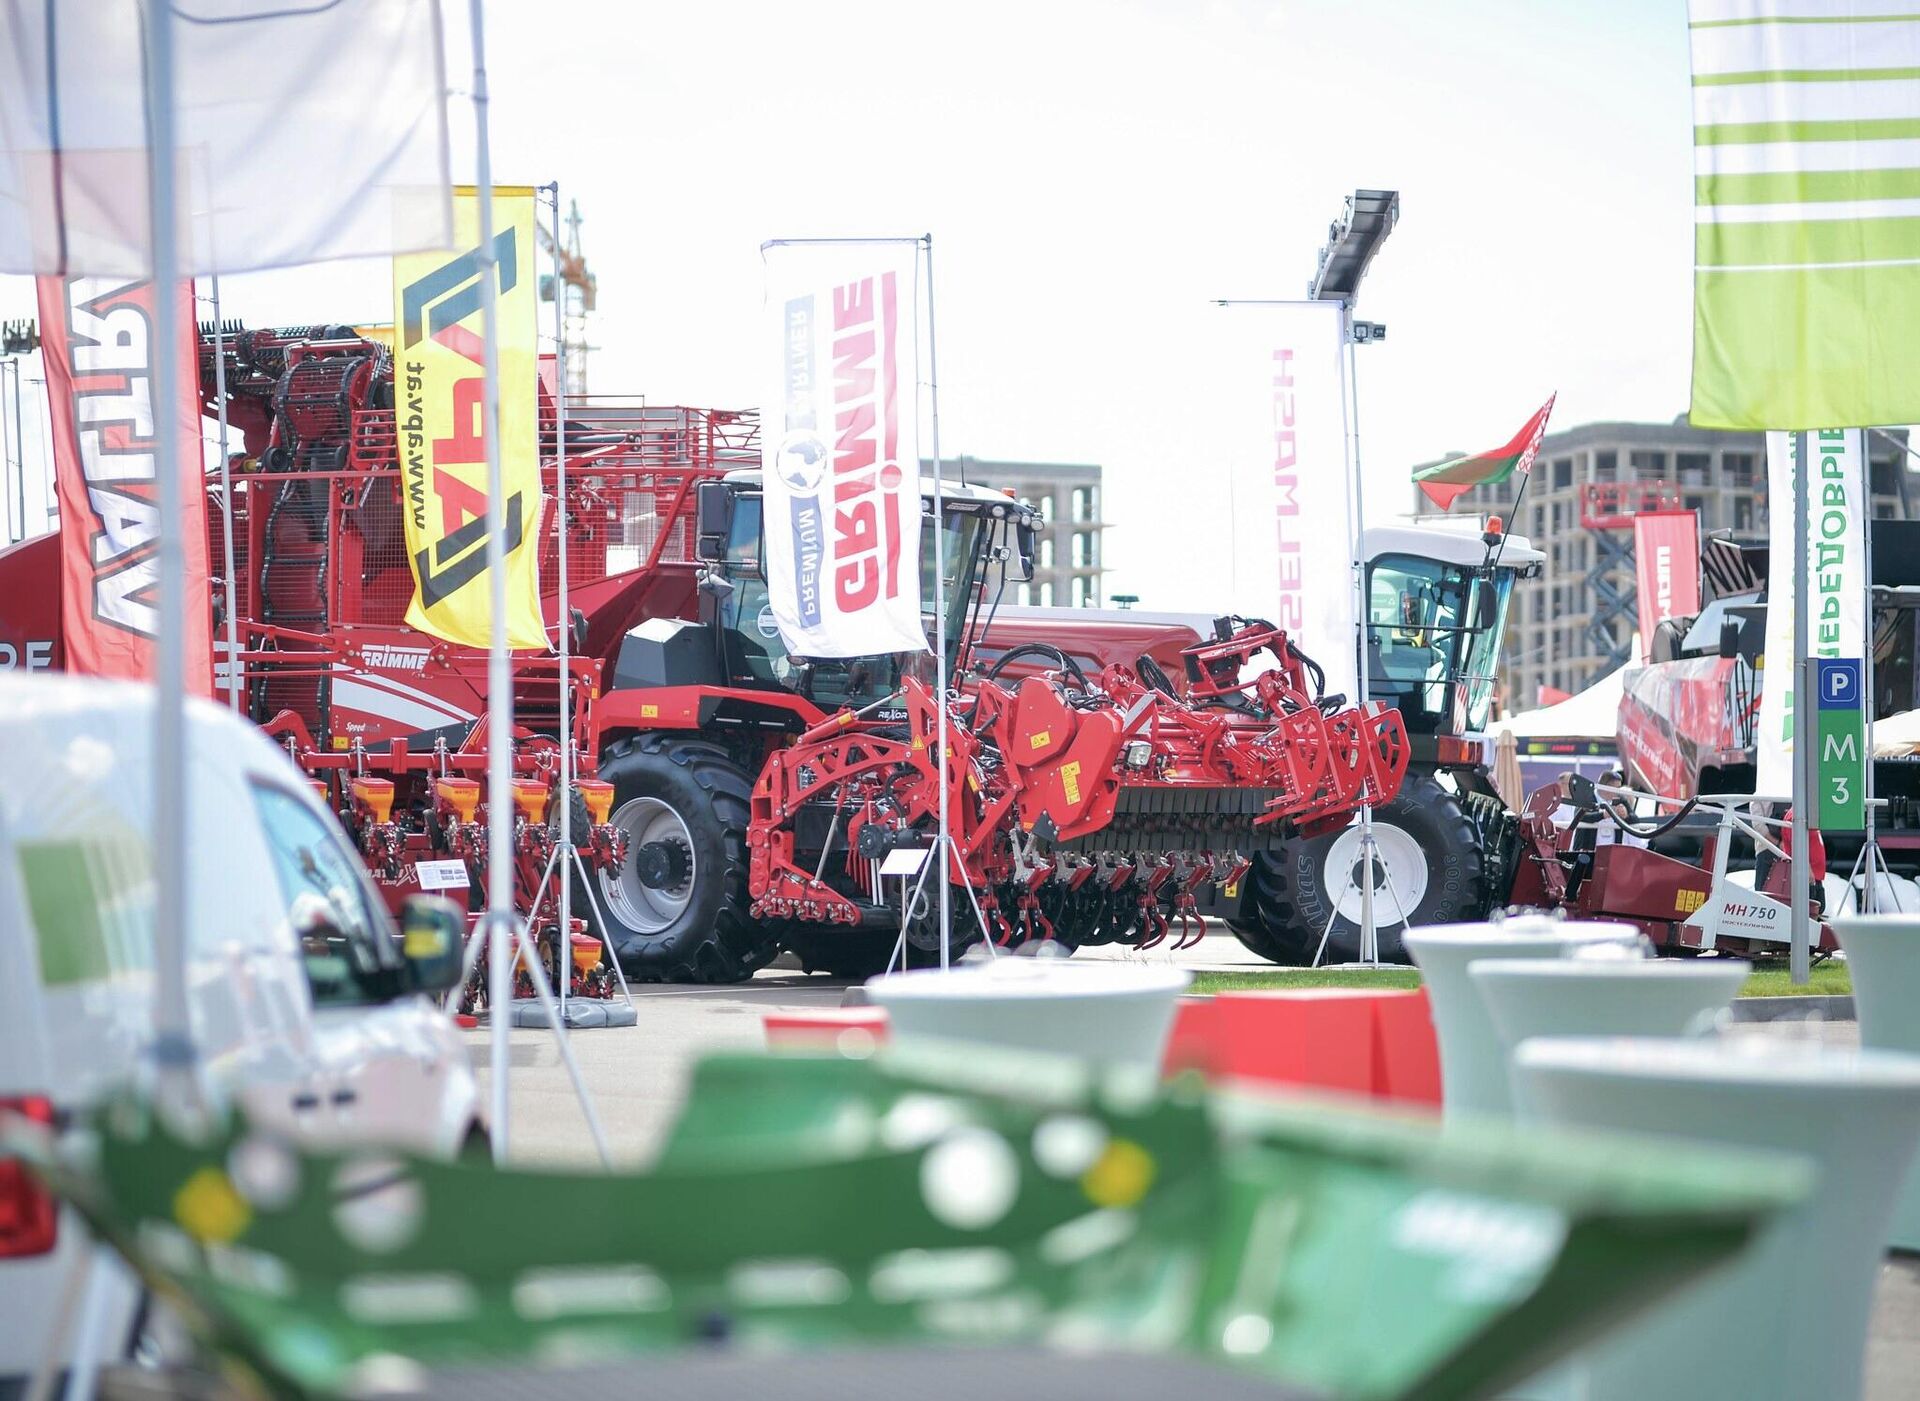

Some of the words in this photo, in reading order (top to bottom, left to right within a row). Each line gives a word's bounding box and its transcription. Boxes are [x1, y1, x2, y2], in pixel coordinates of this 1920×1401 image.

[1831, 672, 1849, 696] P
[1824, 734, 1857, 762] M
[1832, 778, 1850, 805] 3
